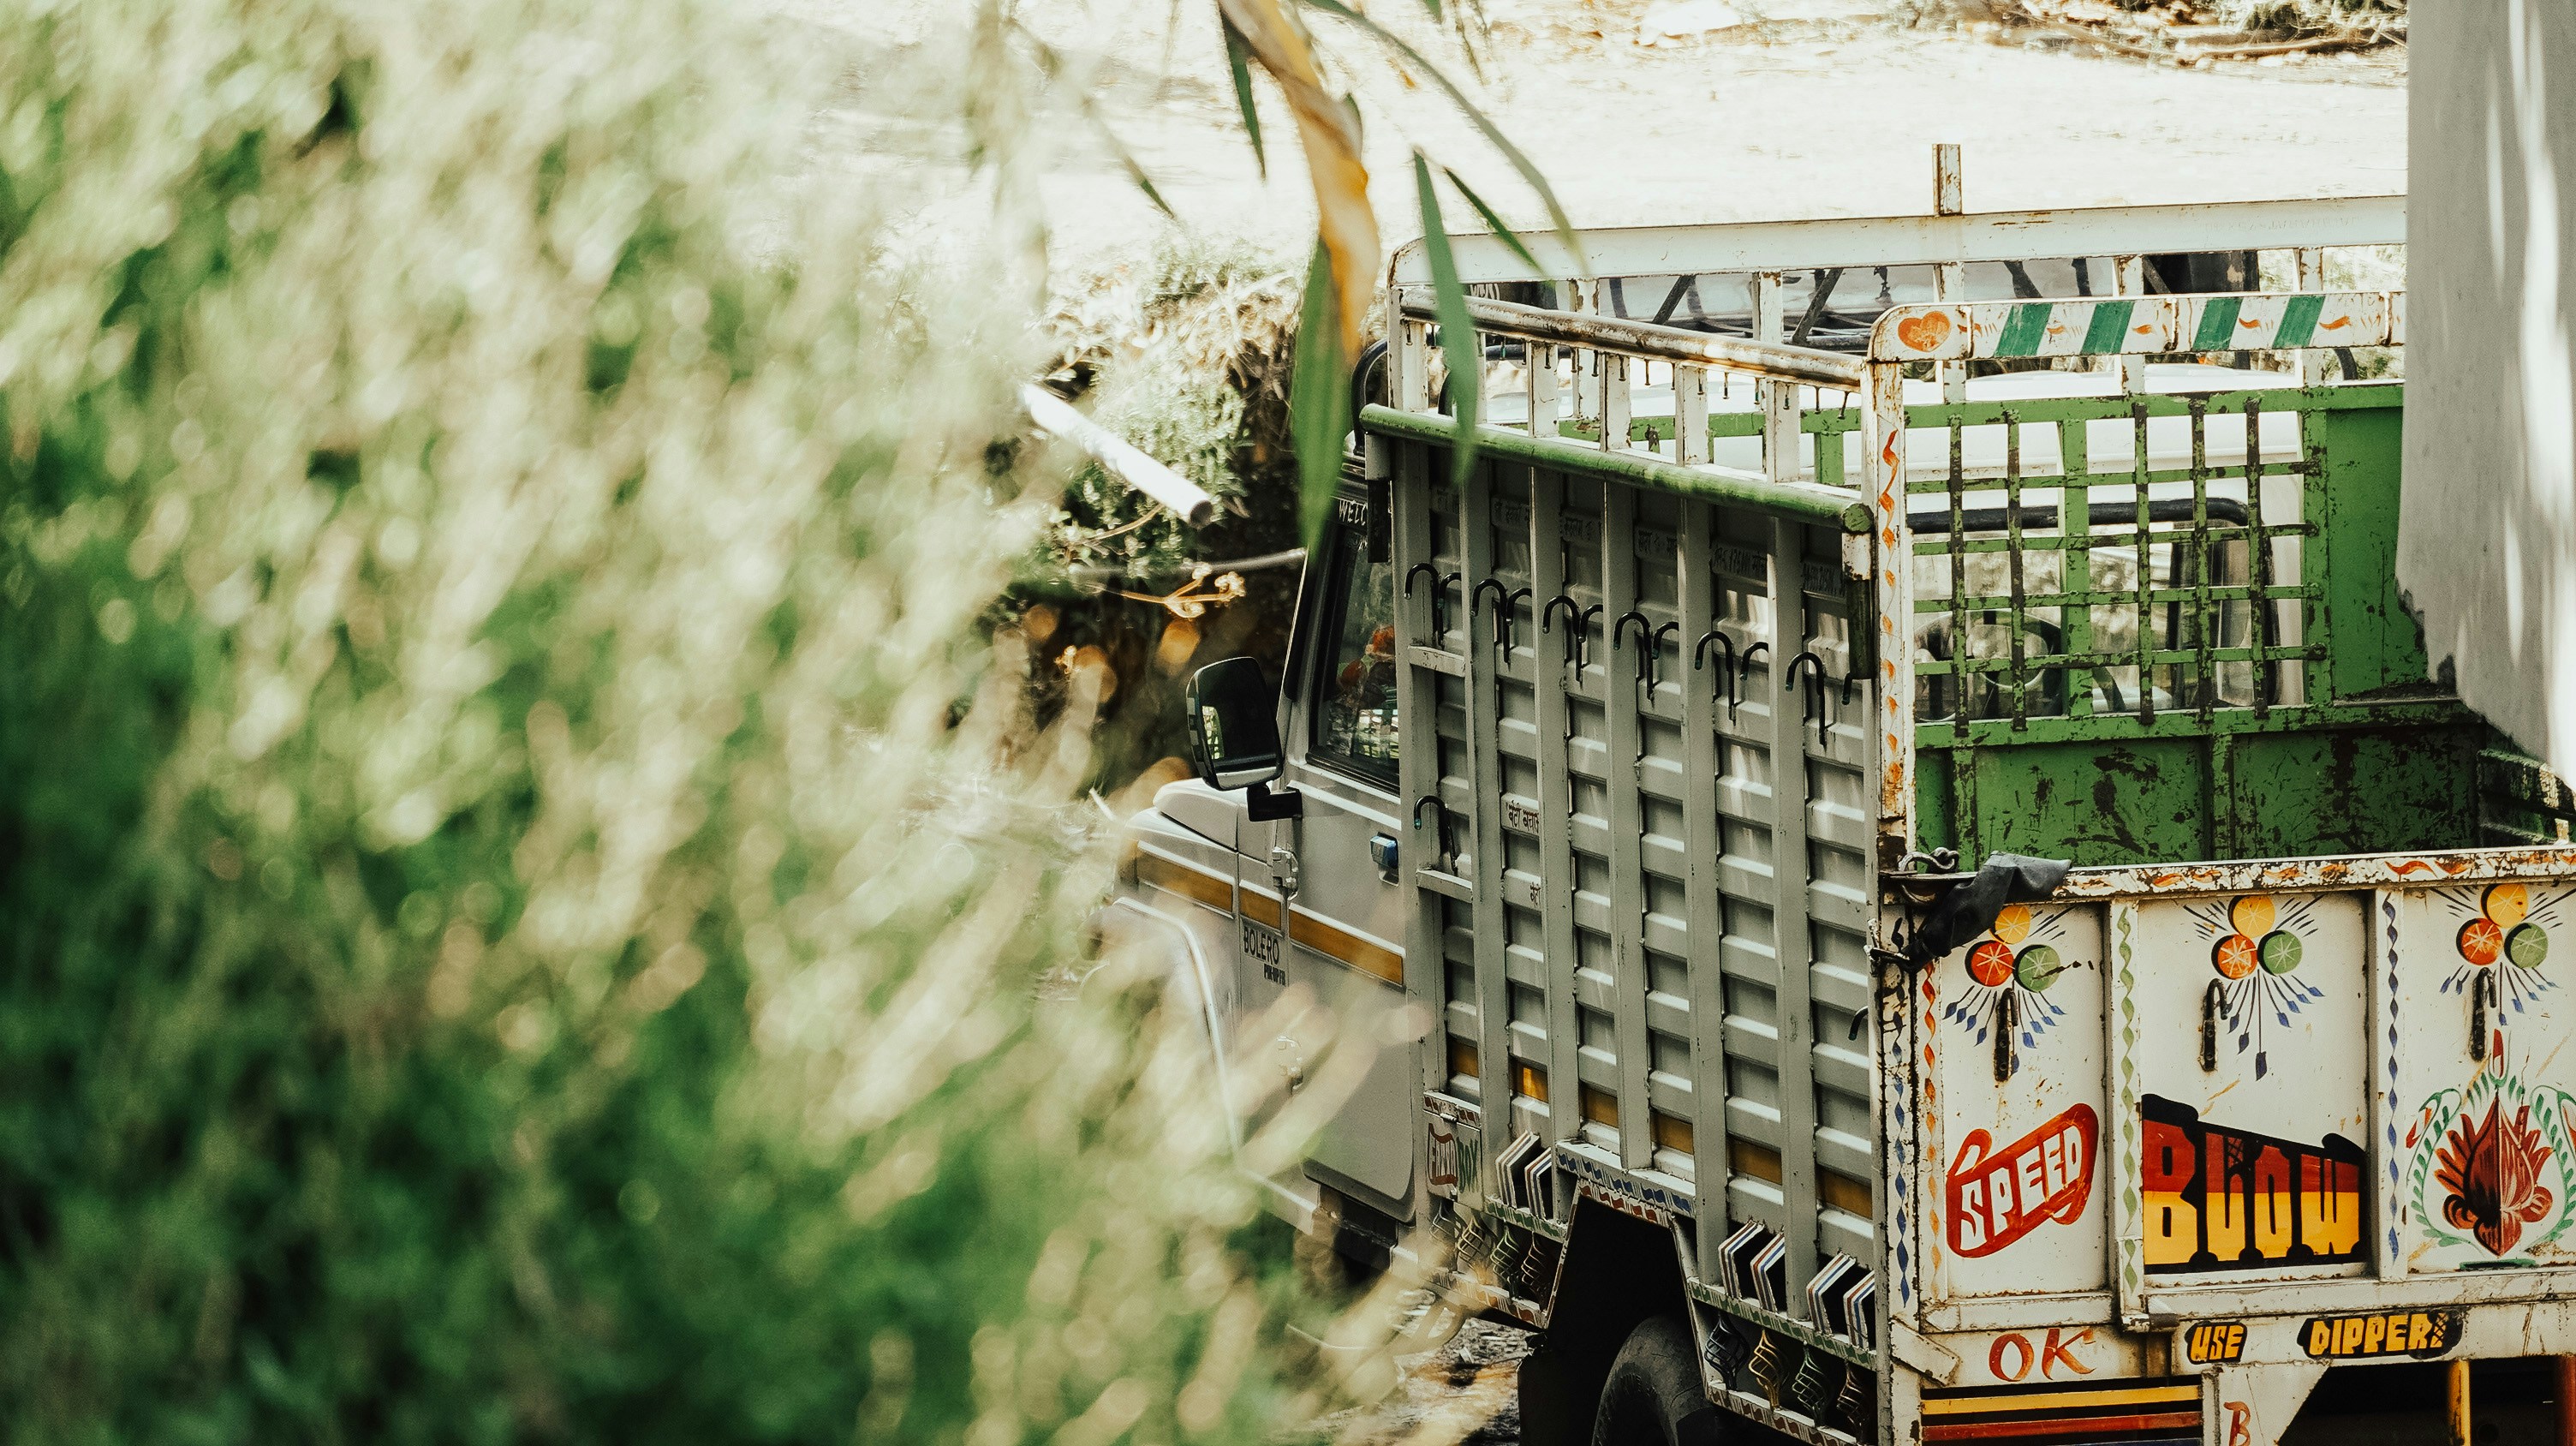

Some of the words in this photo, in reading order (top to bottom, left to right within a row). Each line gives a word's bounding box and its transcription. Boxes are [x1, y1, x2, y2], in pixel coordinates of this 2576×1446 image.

[1339, 500, 1368, 526] WELC
[1243, 926, 1280, 965] BOLERO
[1959, 1123, 2084, 1252] SPEED
[2142, 1117, 2361, 1265] BLOW
[1989, 1328, 2097, 1382] OK
[2190, 1324, 2245, 1362] USE
